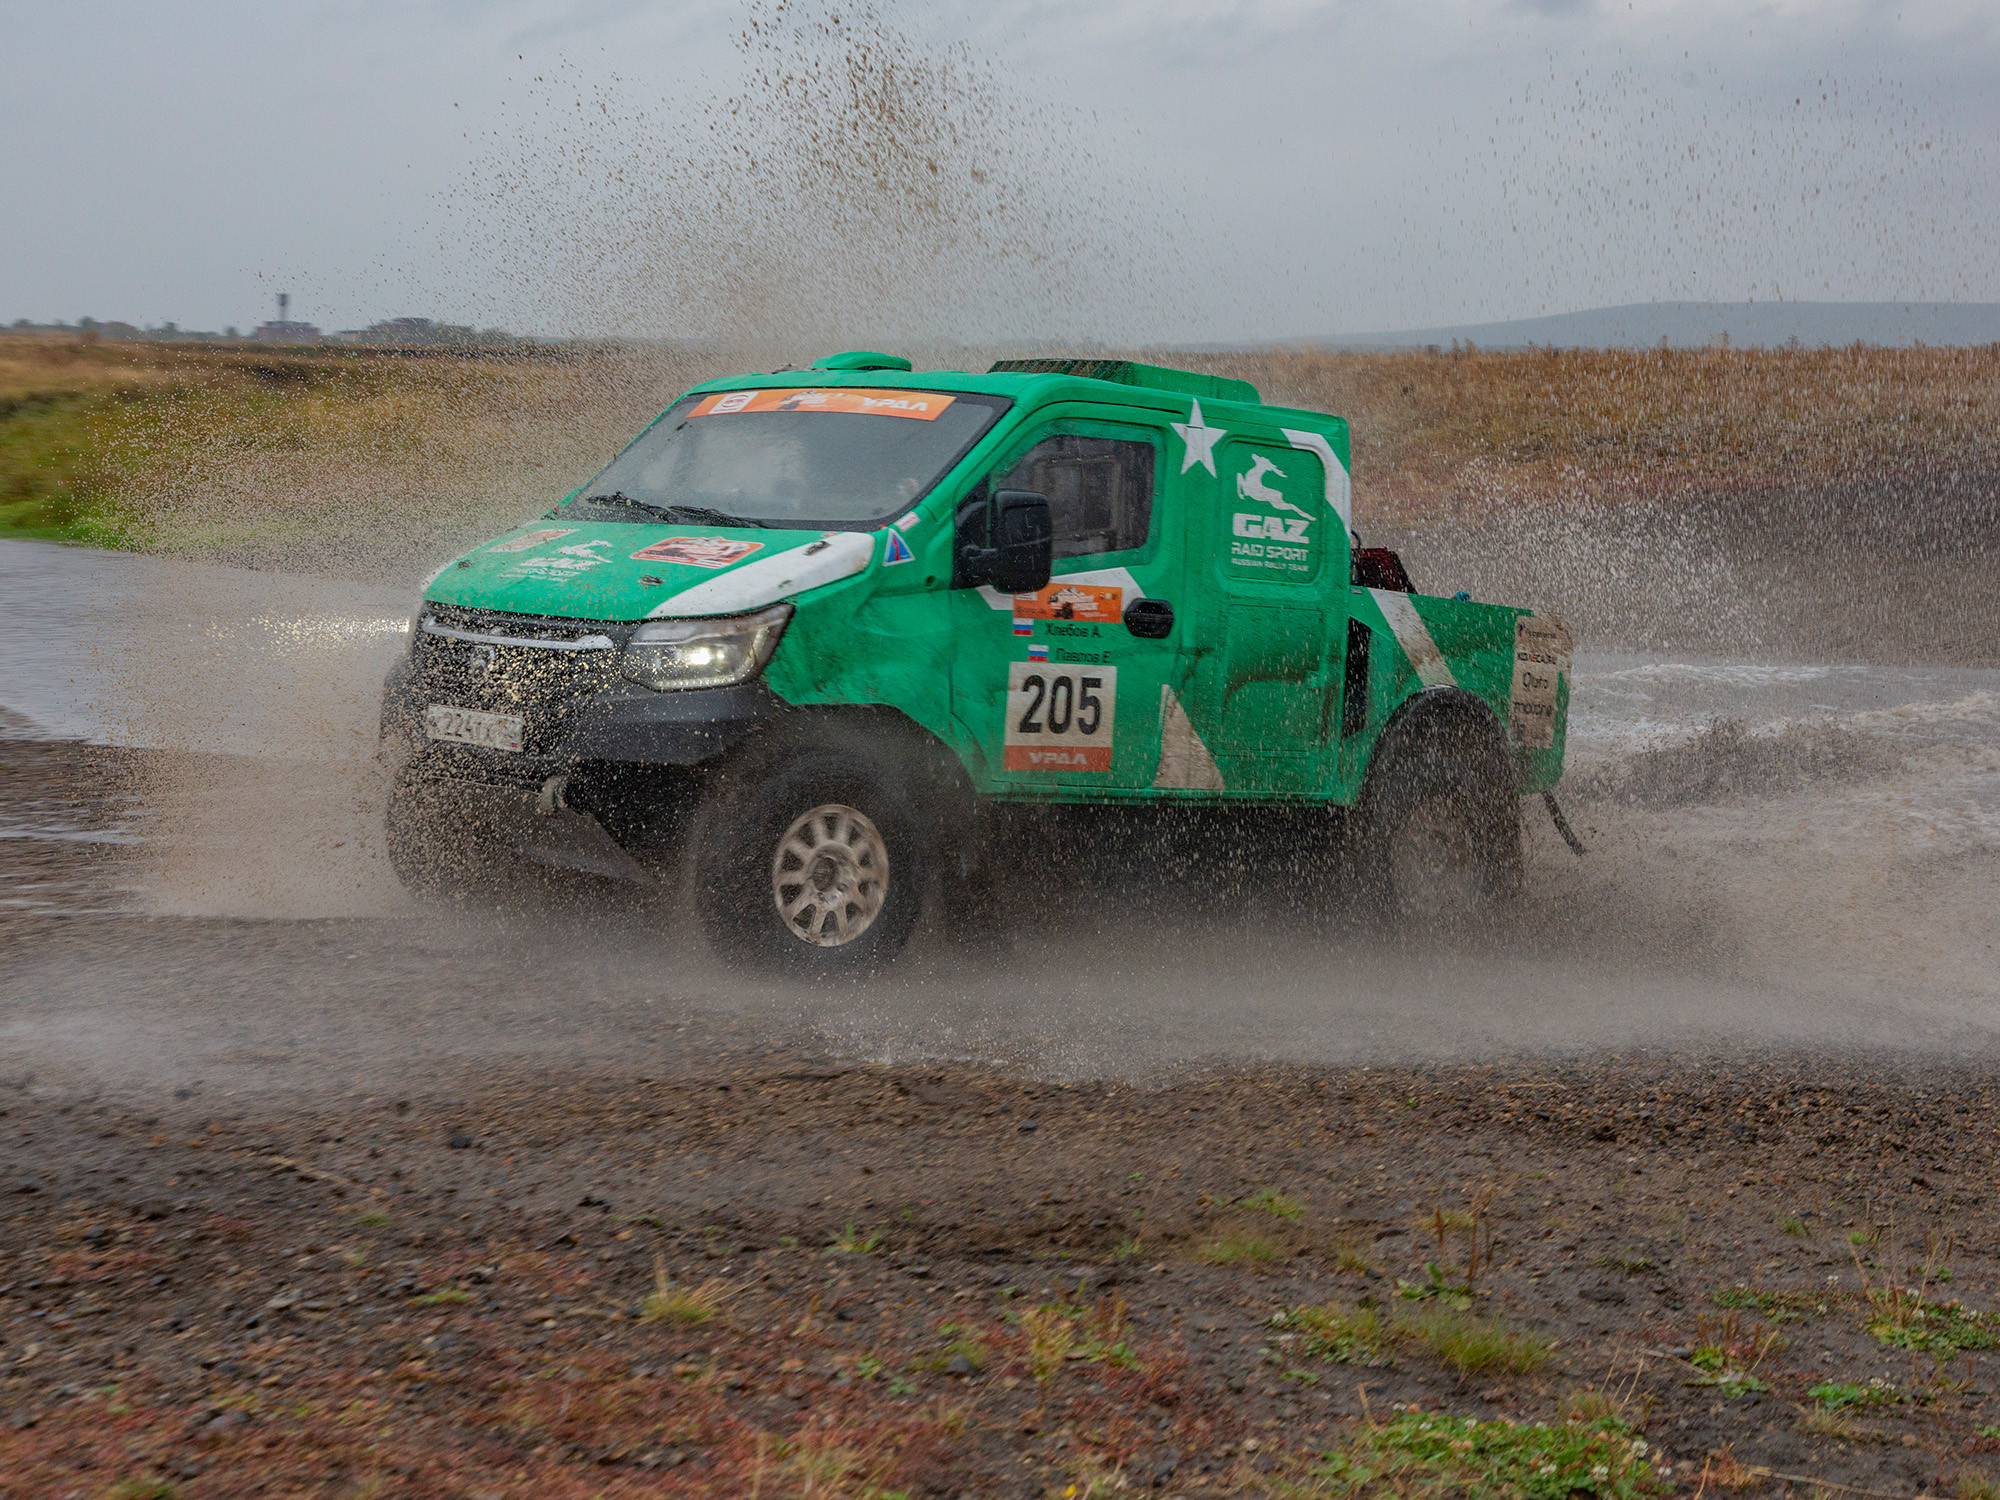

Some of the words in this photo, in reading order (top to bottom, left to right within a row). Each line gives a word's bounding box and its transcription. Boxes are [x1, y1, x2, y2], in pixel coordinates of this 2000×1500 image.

[1232, 512, 1310, 544] GAZ
[1231, 542, 1265, 556] RAID
[1266, 546, 1309, 561] SPORT
[1018, 674, 1103, 735] 205
